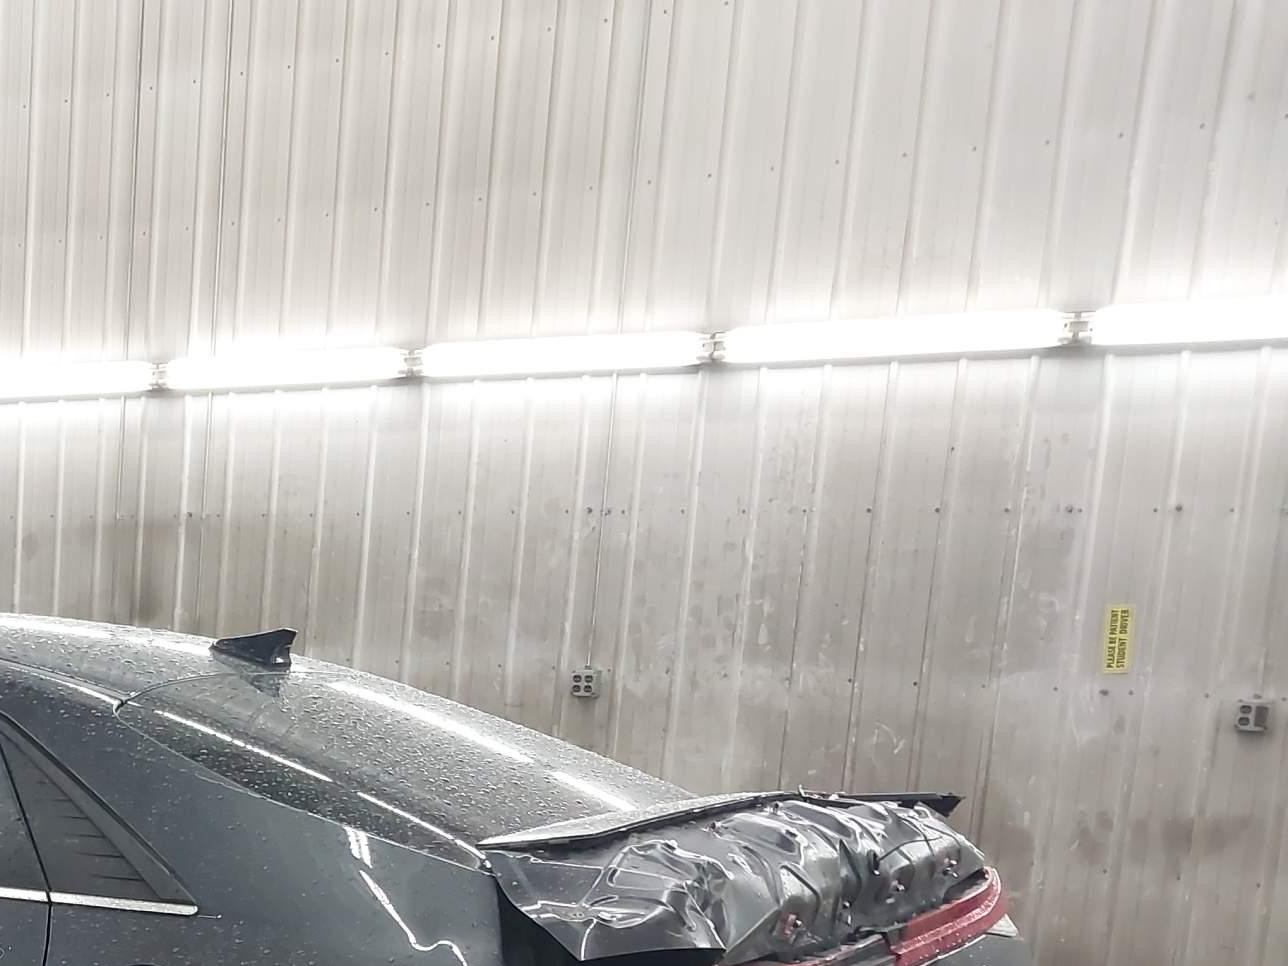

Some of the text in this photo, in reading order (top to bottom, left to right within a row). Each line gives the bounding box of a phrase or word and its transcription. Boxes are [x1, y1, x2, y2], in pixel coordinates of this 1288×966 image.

[1109, 610, 1119, 635] PATIENT
[1115, 609, 1129, 668] STUDENT DRIVER
[1106, 646, 1115, 668] PLEASE
